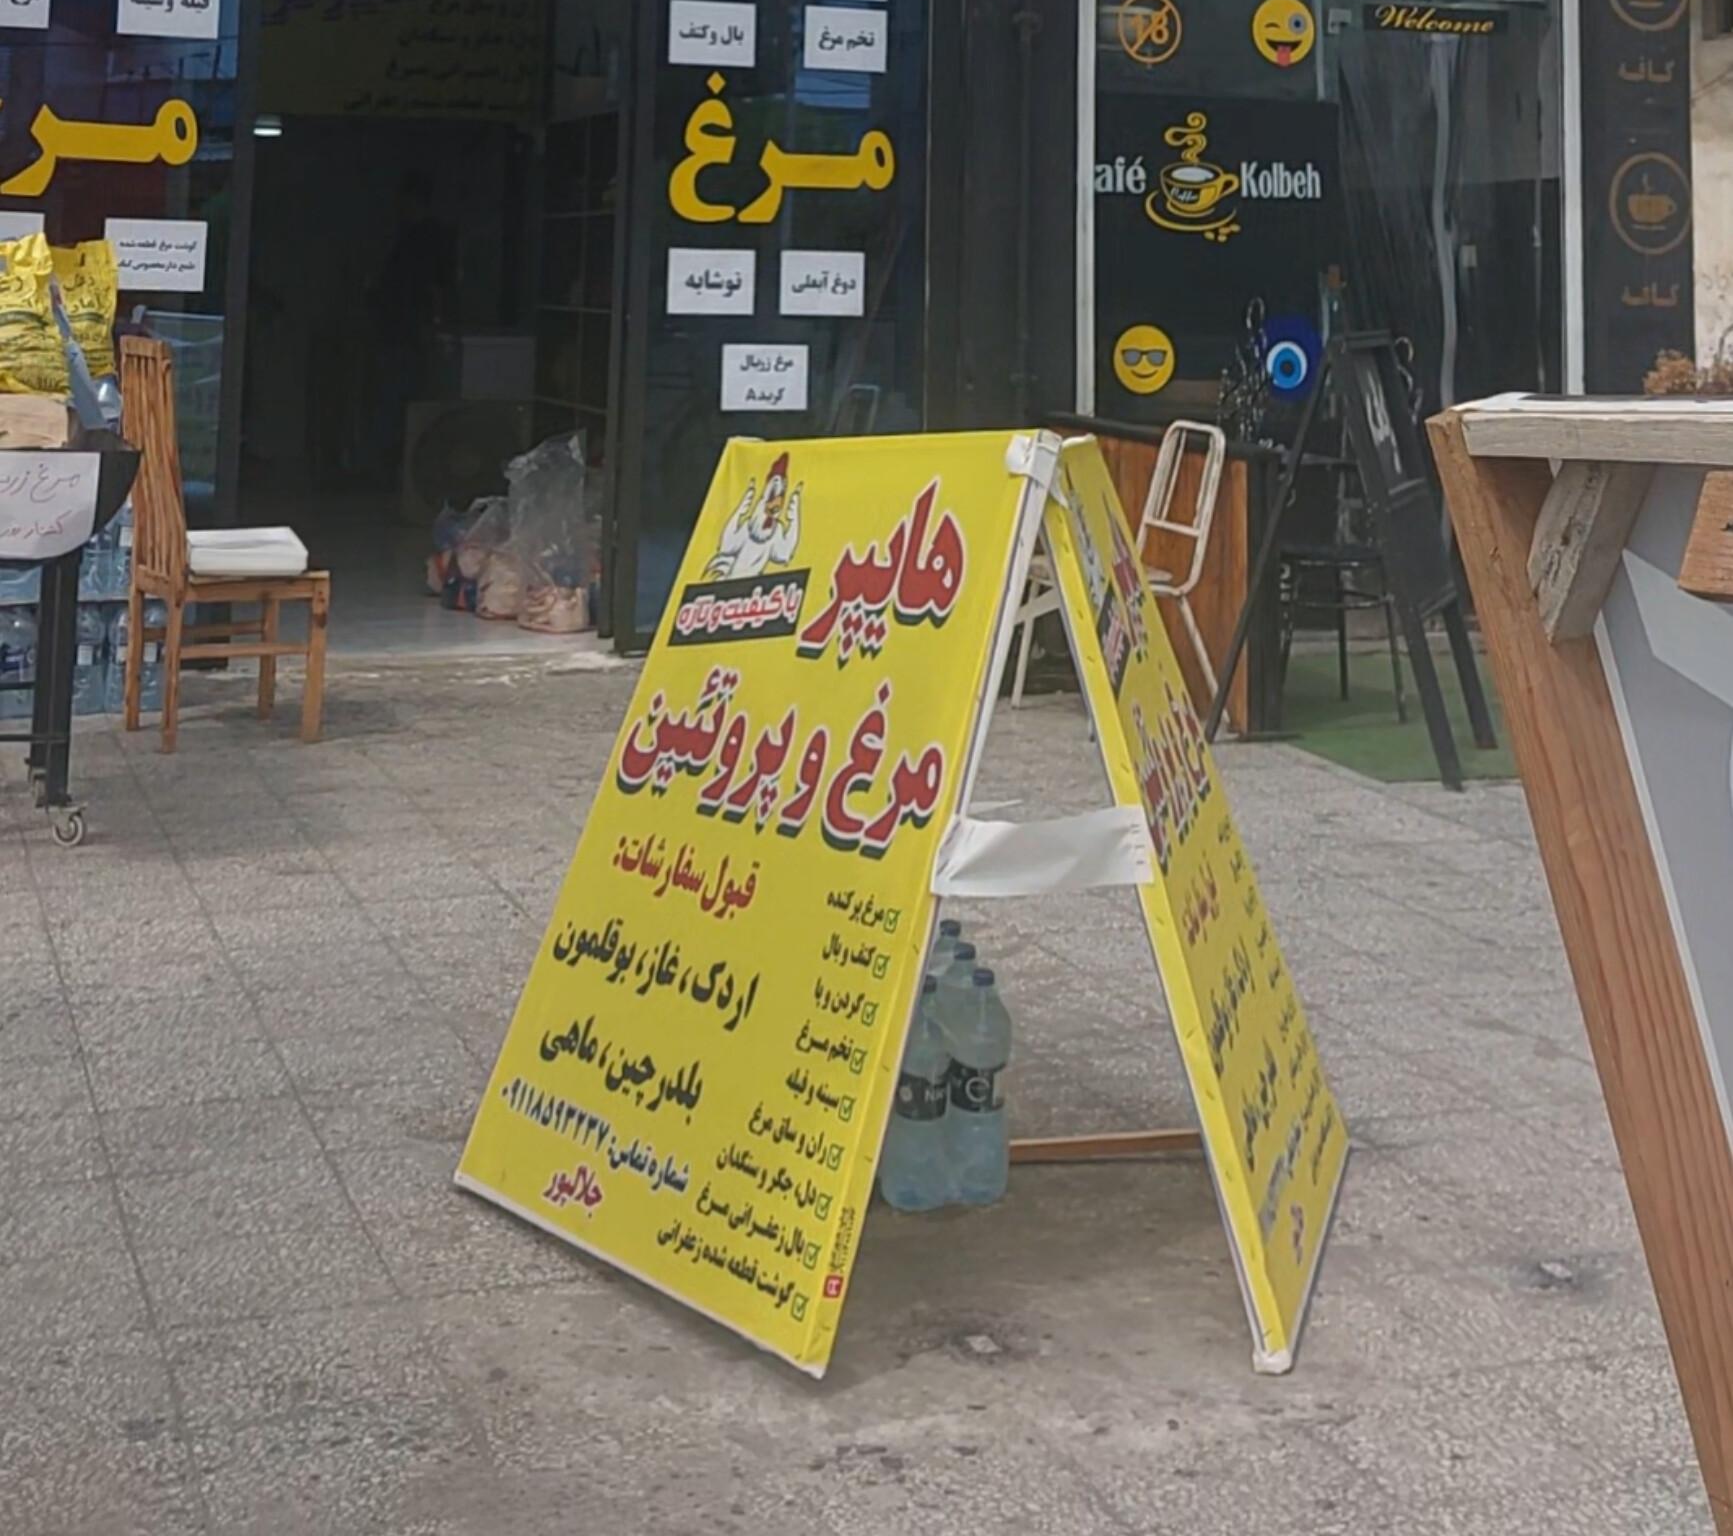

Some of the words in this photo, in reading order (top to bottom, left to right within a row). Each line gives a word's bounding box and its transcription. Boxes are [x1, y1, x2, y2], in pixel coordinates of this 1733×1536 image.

[721, 25, 744, 46] بال
[818, 25, 843, 51] مرغ
[1375, 4, 1495, 32] Welcome
[846, 29, 875, 52] تخم
[0, 99, 199, 197] مر
[668, 70, 896, 224] مرغ
[1095, 156, 1147, 194] afé
[1240, 160, 1322, 199] Kolbeh
[773, 353, 794, 373] مرغ
[30, 462, 81, 504] مرغ
[797, 477, 967, 667] هایپر
[617, 666, 797, 832] پروتئین
[823, 680, 945, 852] مرغ
[700, 854, 761, 919] قبول
[860, 894, 885, 927] مرغ
[552, 918, 638, 985] بوقلمون
[539, 1014, 598, 1063] ماهی
[795, 1018, 830, 1054] مرغ
[748, 1100, 774, 1137] مرغ
[542, 1164, 604, 1220] جلالپور
[696, 1181, 731, 1216] مرغ
